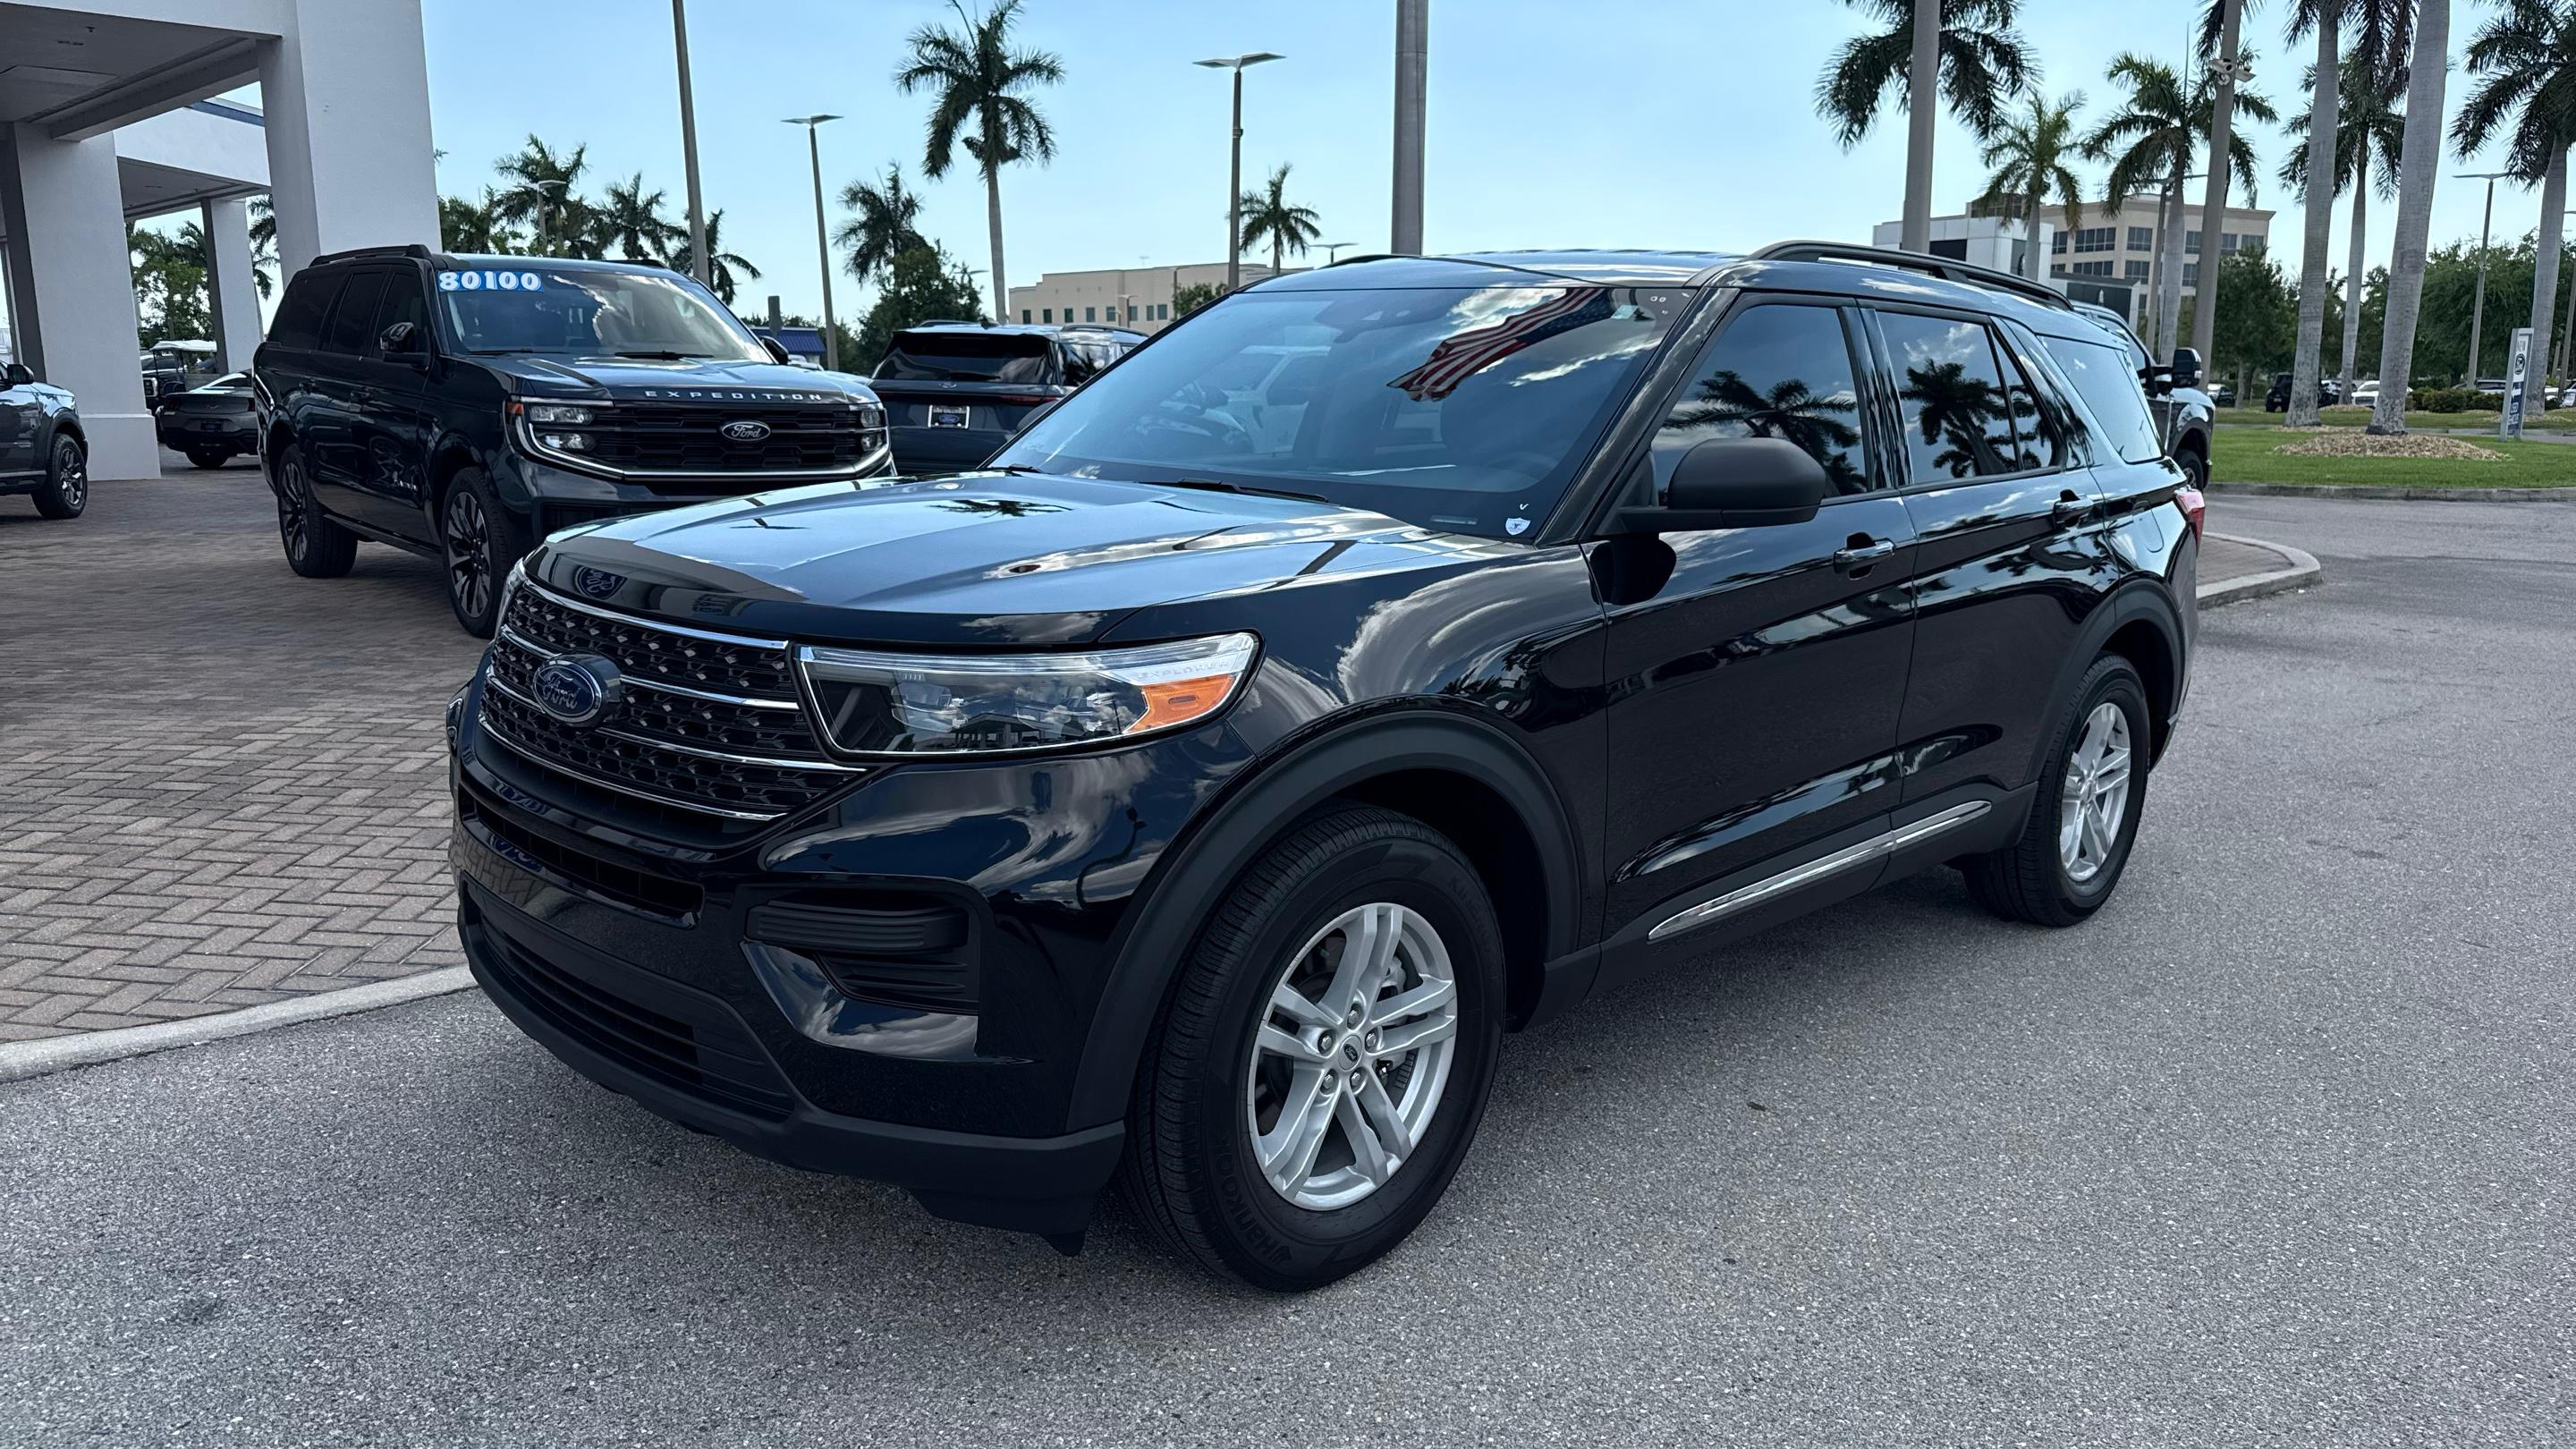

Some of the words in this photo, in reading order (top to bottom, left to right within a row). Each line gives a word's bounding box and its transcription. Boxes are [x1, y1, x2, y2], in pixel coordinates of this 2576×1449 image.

[439, 271, 541, 291] 80100
[645, 391, 822, 401] EXPEDITION
[1138, 661, 1229, 678] EXPLORER
